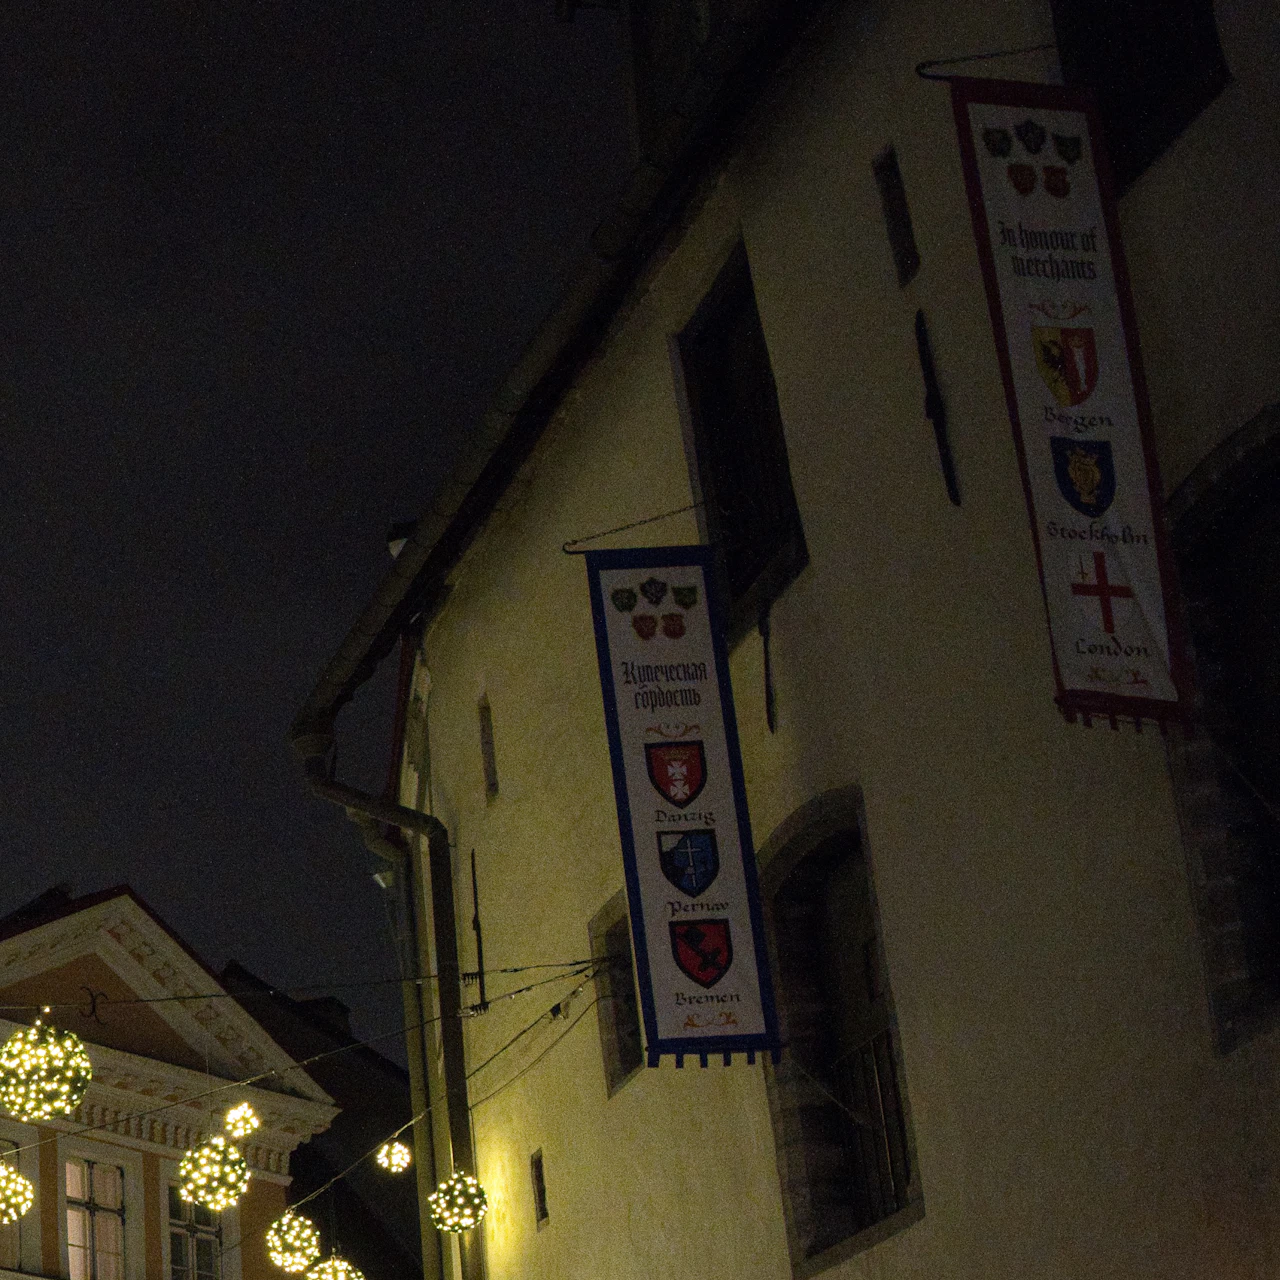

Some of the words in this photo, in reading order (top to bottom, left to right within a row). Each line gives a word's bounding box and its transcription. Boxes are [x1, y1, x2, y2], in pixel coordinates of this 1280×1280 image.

[998, 220, 1017, 247] In
[1018, 221, 1078, 251] honour
[1081, 226, 1097, 252] of
[1012, 253, 1097, 283] merchants
[1044, 406, 1114, 433] Bergen
[1046, 520, 1149, 545] Stockholm
[1074, 636, 1151, 658] London
[620, 661, 708, 685] Купеческая
[634, 686, 701, 712] гордость
[654, 809, 716, 826] Danzig
[674, 991, 741, 1006] Bremen
